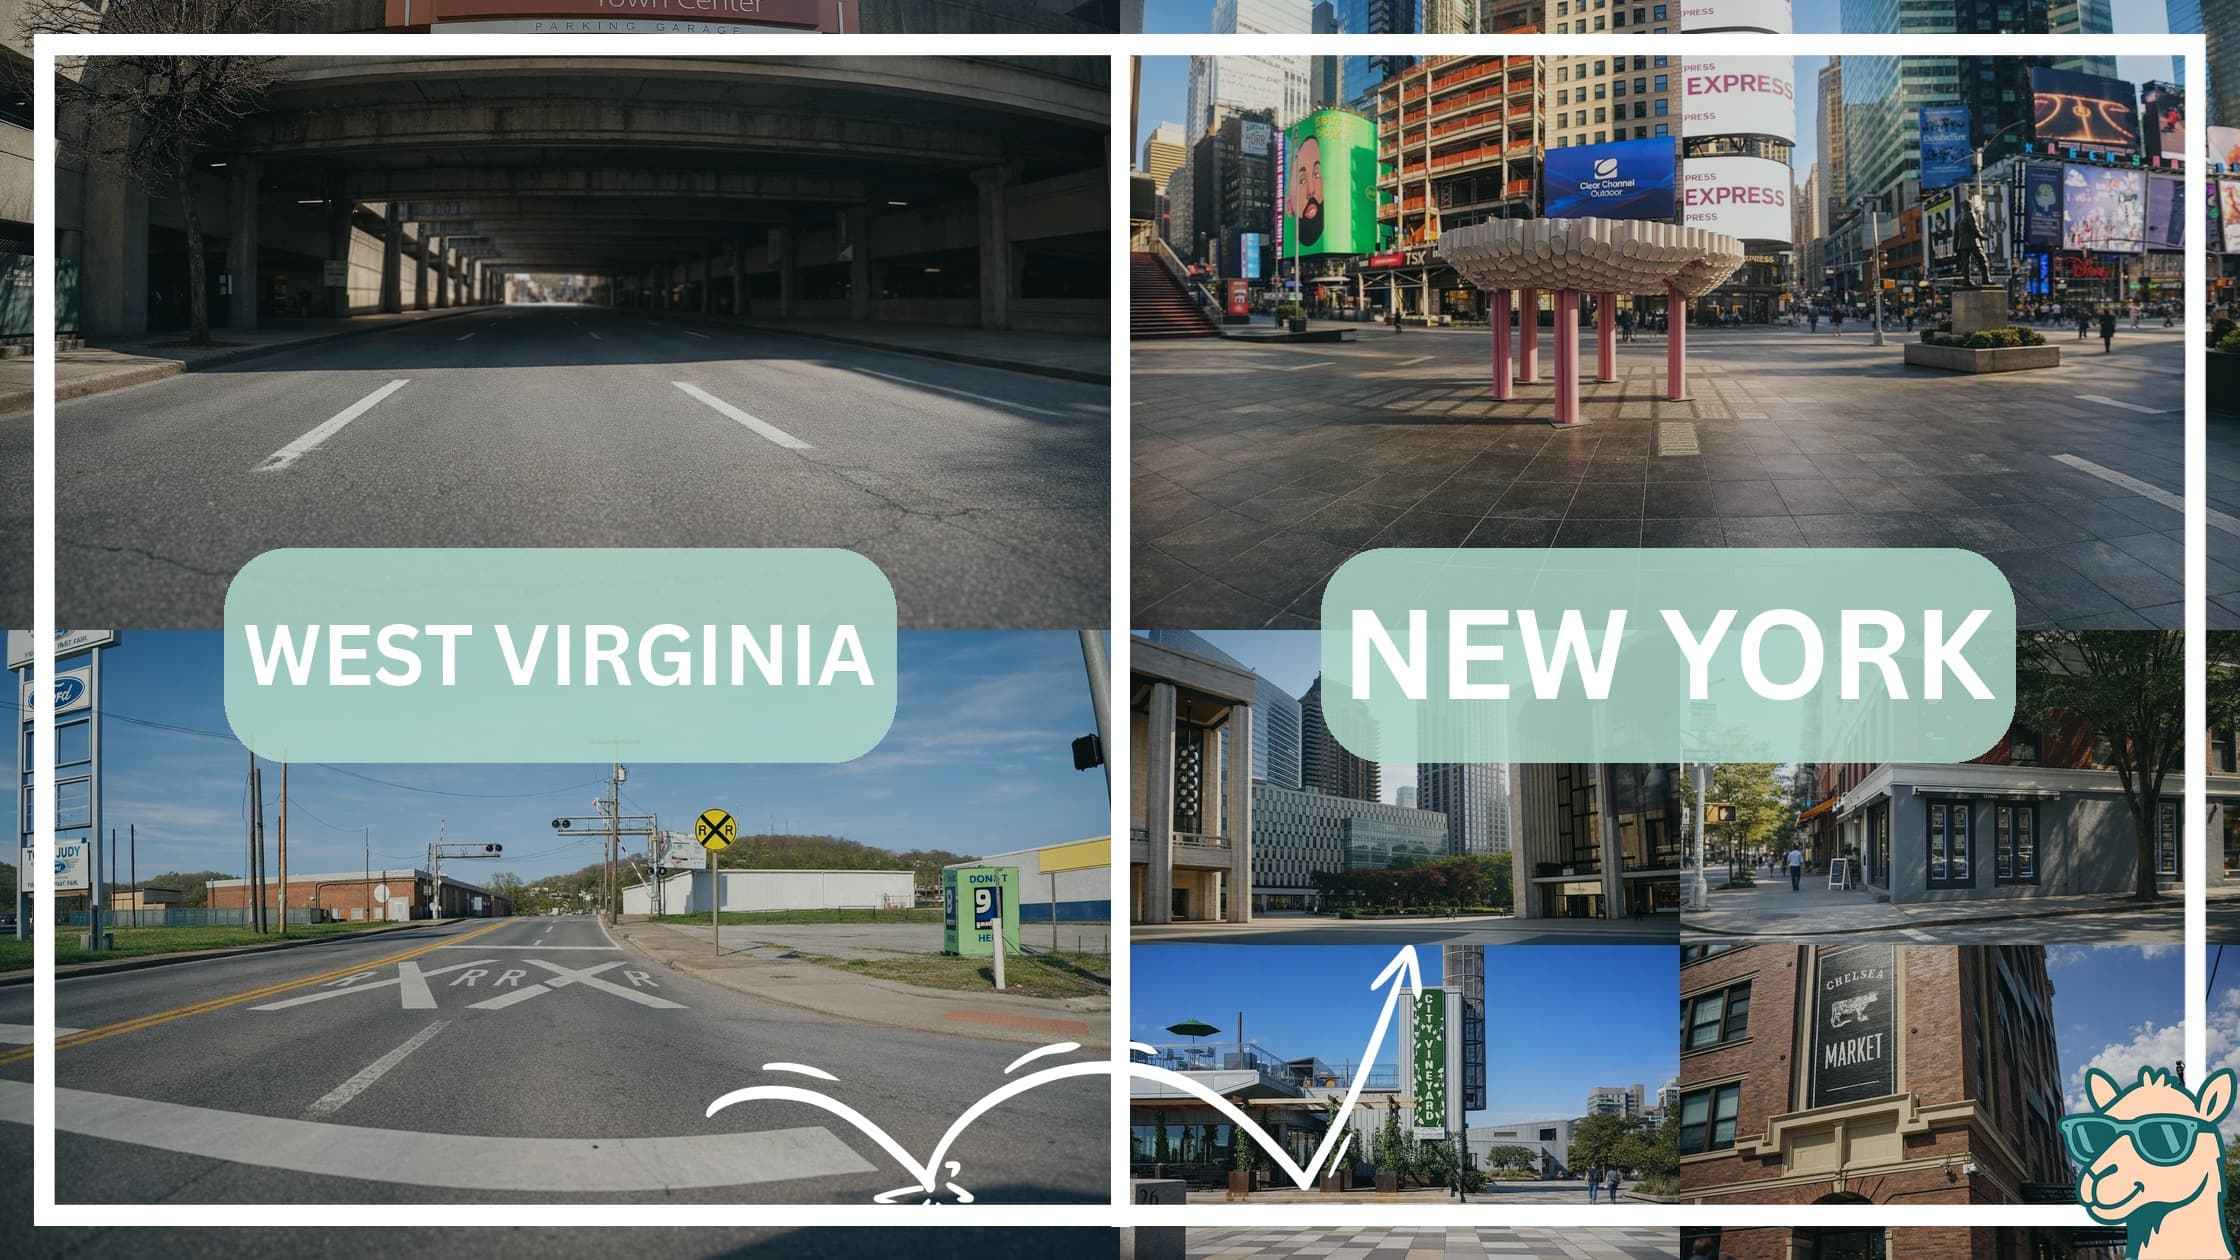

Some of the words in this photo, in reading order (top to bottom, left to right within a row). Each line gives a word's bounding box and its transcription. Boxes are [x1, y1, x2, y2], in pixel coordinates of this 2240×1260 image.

[535, 22, 635, 31] PARKING
[656, 23, 742, 34] GARAGE
[1687, 74, 1793, 100] EXPRESS
[1685, 173, 1717, 181] PRESS
[1580, 182, 1600, 190] Clear
[1601, 178, 1635, 188] Channel
[1590, 189, 1623, 198] Outdoor
[1685, 186, 1785, 207] EXPRESS
[1686, 213, 1718, 221] PRESS
[1405, 251, 1427, 265] TSX
[56, 846, 80, 858] JUDY
[978, 934, 993, 942] HE
[1826, 968, 1884, 990] CHELSEA
[1424, 994, 1434, 1033] CITY
[1824, 1032, 1884, 1070] MARKET
[1424, 1039, 1434, 1120] VINEYARD
